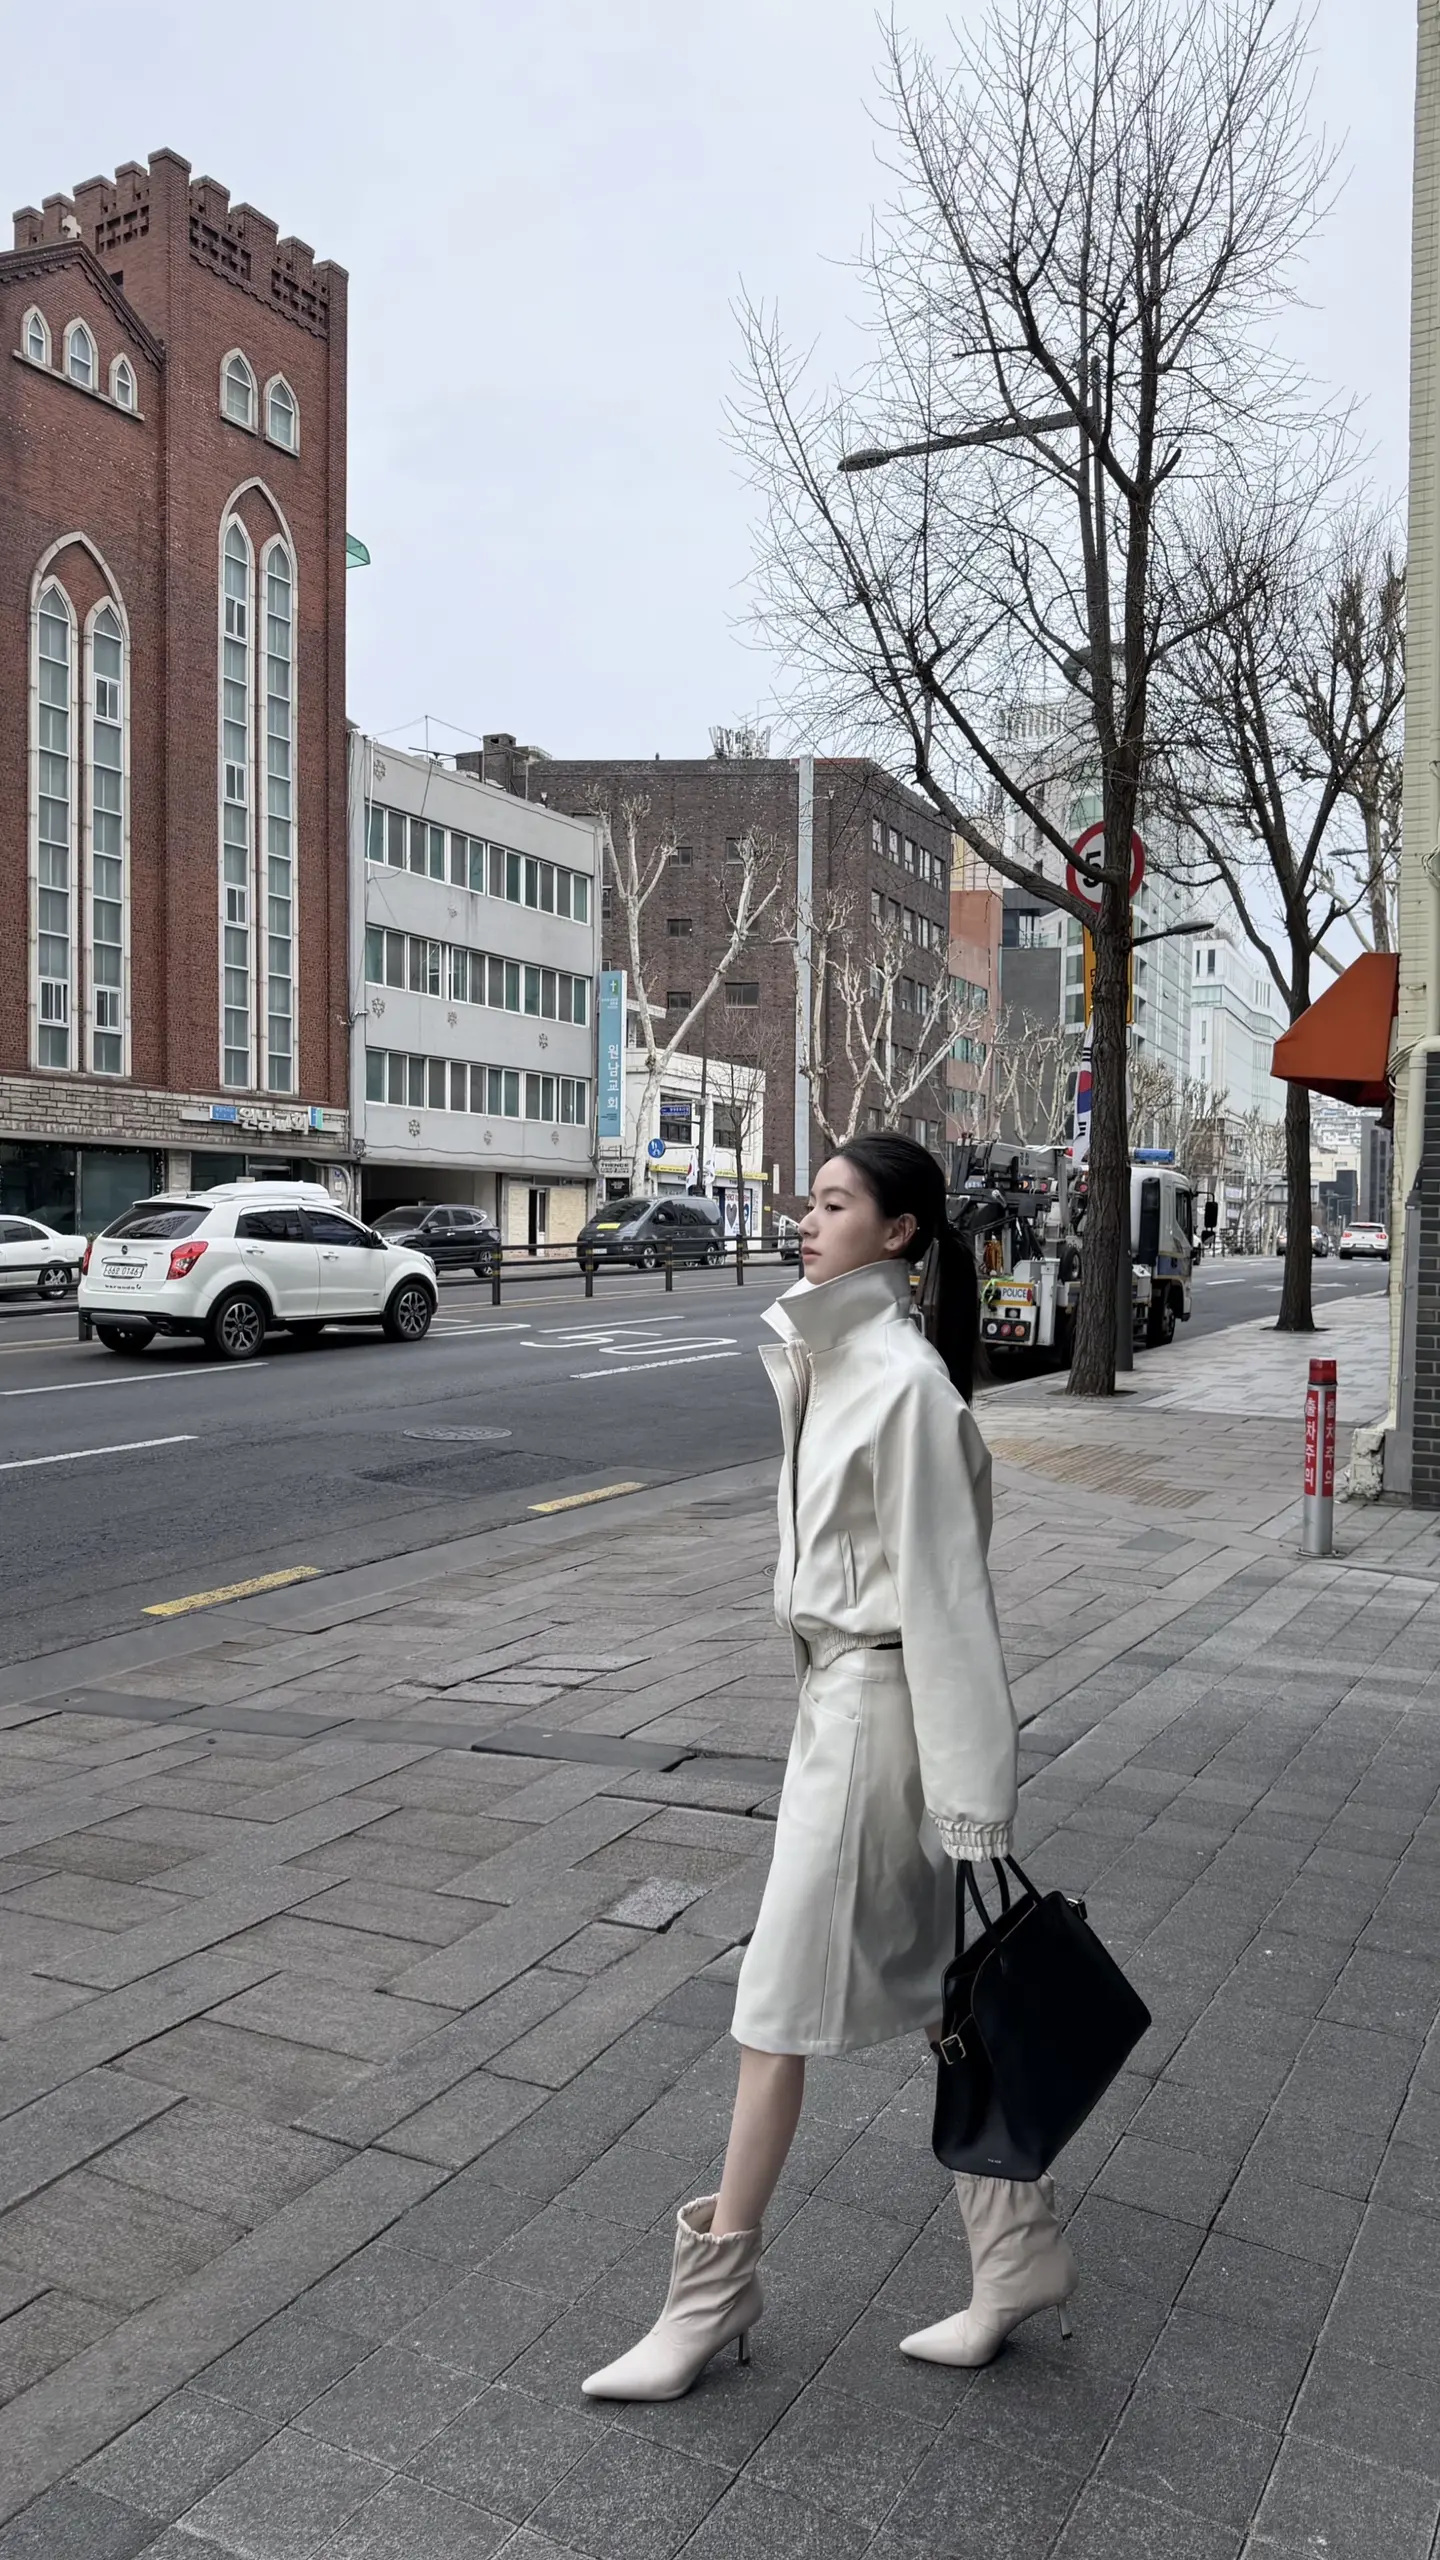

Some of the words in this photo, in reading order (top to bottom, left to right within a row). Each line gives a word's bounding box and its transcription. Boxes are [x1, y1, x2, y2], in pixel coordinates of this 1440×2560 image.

[606, 1044, 619, 1110] 원남교회
[239, 1107, 309, 1136] 원남교회
[1002, 1287, 1027, 1298] POLICE
[1304, 1396, 1317, 1488] 출차주의
